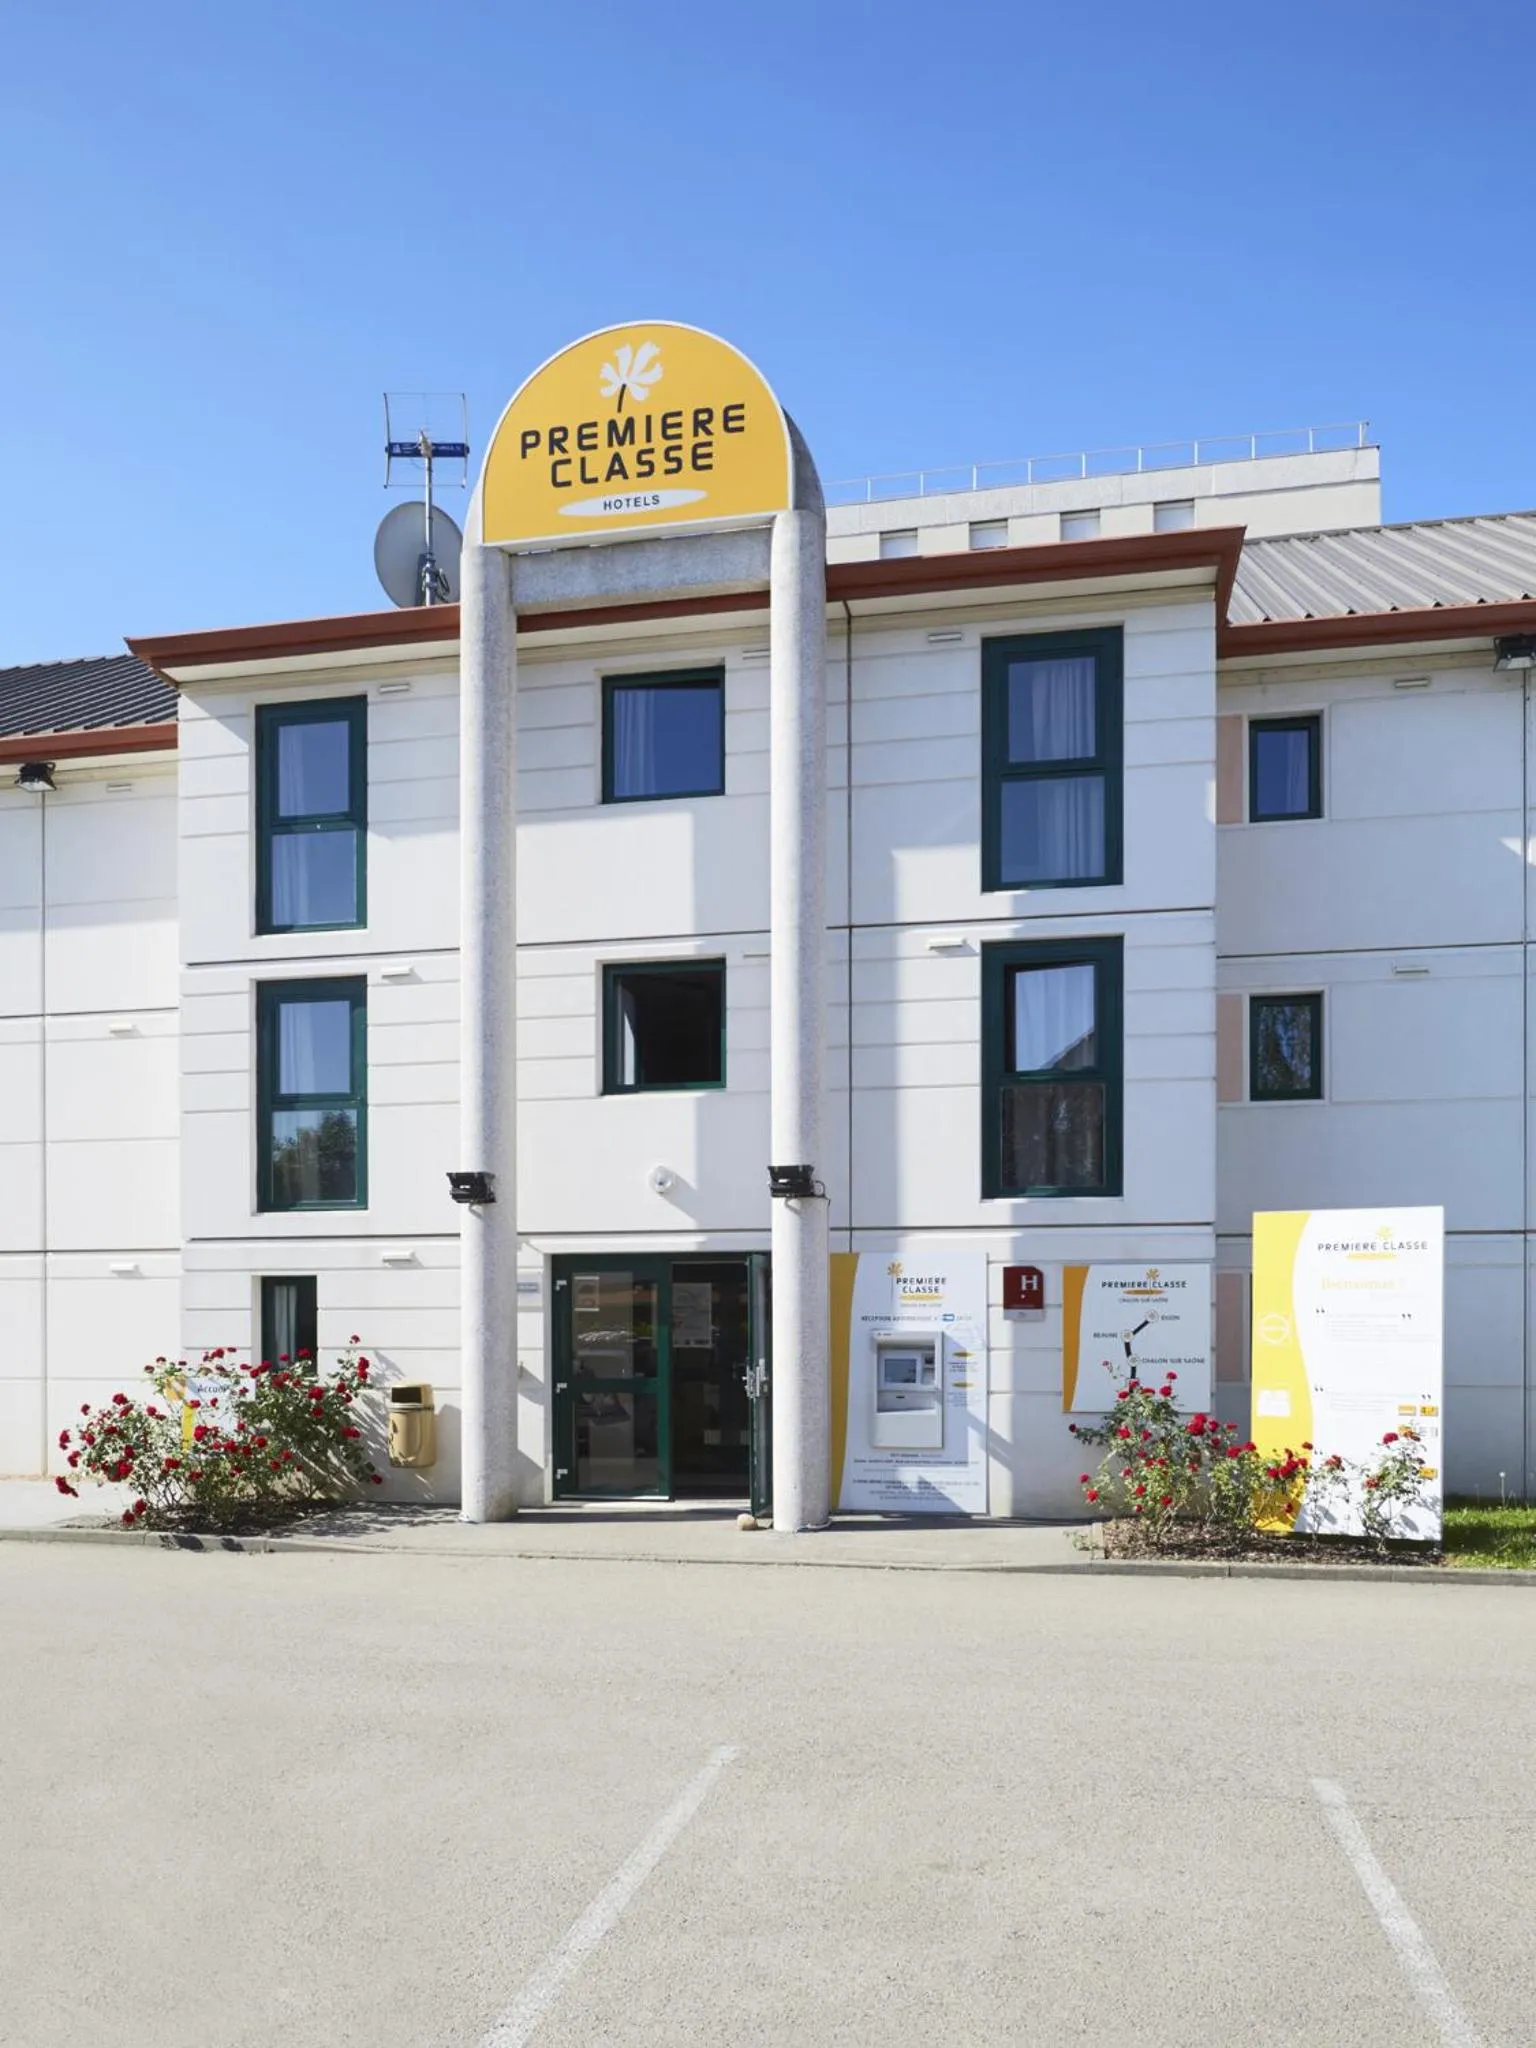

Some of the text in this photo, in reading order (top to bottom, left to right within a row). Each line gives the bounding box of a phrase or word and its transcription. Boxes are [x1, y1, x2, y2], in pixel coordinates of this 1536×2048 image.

[521, 404, 745, 459] PREMIERE
[551, 441, 714, 488] CLASSE
[603, 495, 660, 510] HOTELS
[1317, 1241, 1428, 1251] PREMIERE CLASSE
[1021, 1275, 1038, 1291] H
[1101, 1281, 1148, 1289] PREMIERE
